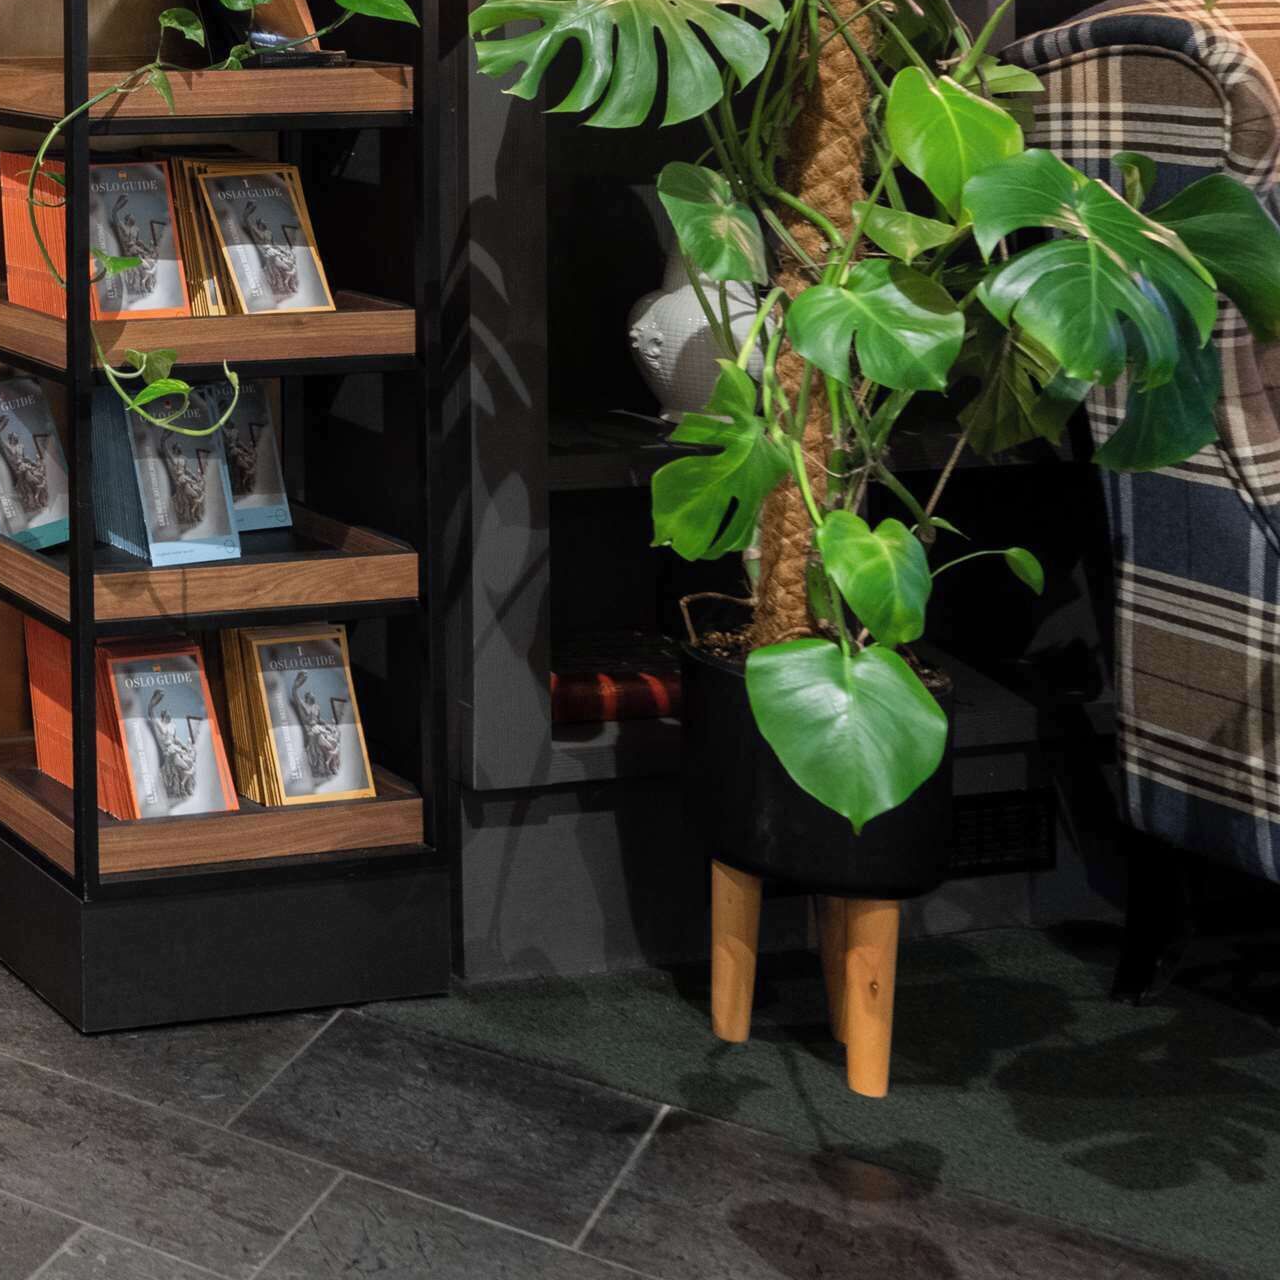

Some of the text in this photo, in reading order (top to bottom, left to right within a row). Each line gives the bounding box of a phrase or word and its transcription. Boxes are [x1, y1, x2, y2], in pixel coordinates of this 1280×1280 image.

[90, 180, 158, 193] OSLO GUIDE
[217, 187, 282, 200] OSLO GUIDE
[1, 394, 36, 412] GUIDE
[270, 655, 336, 670] OSLO GUIDE
[124, 673, 192, 689] OSLO GUIDE
